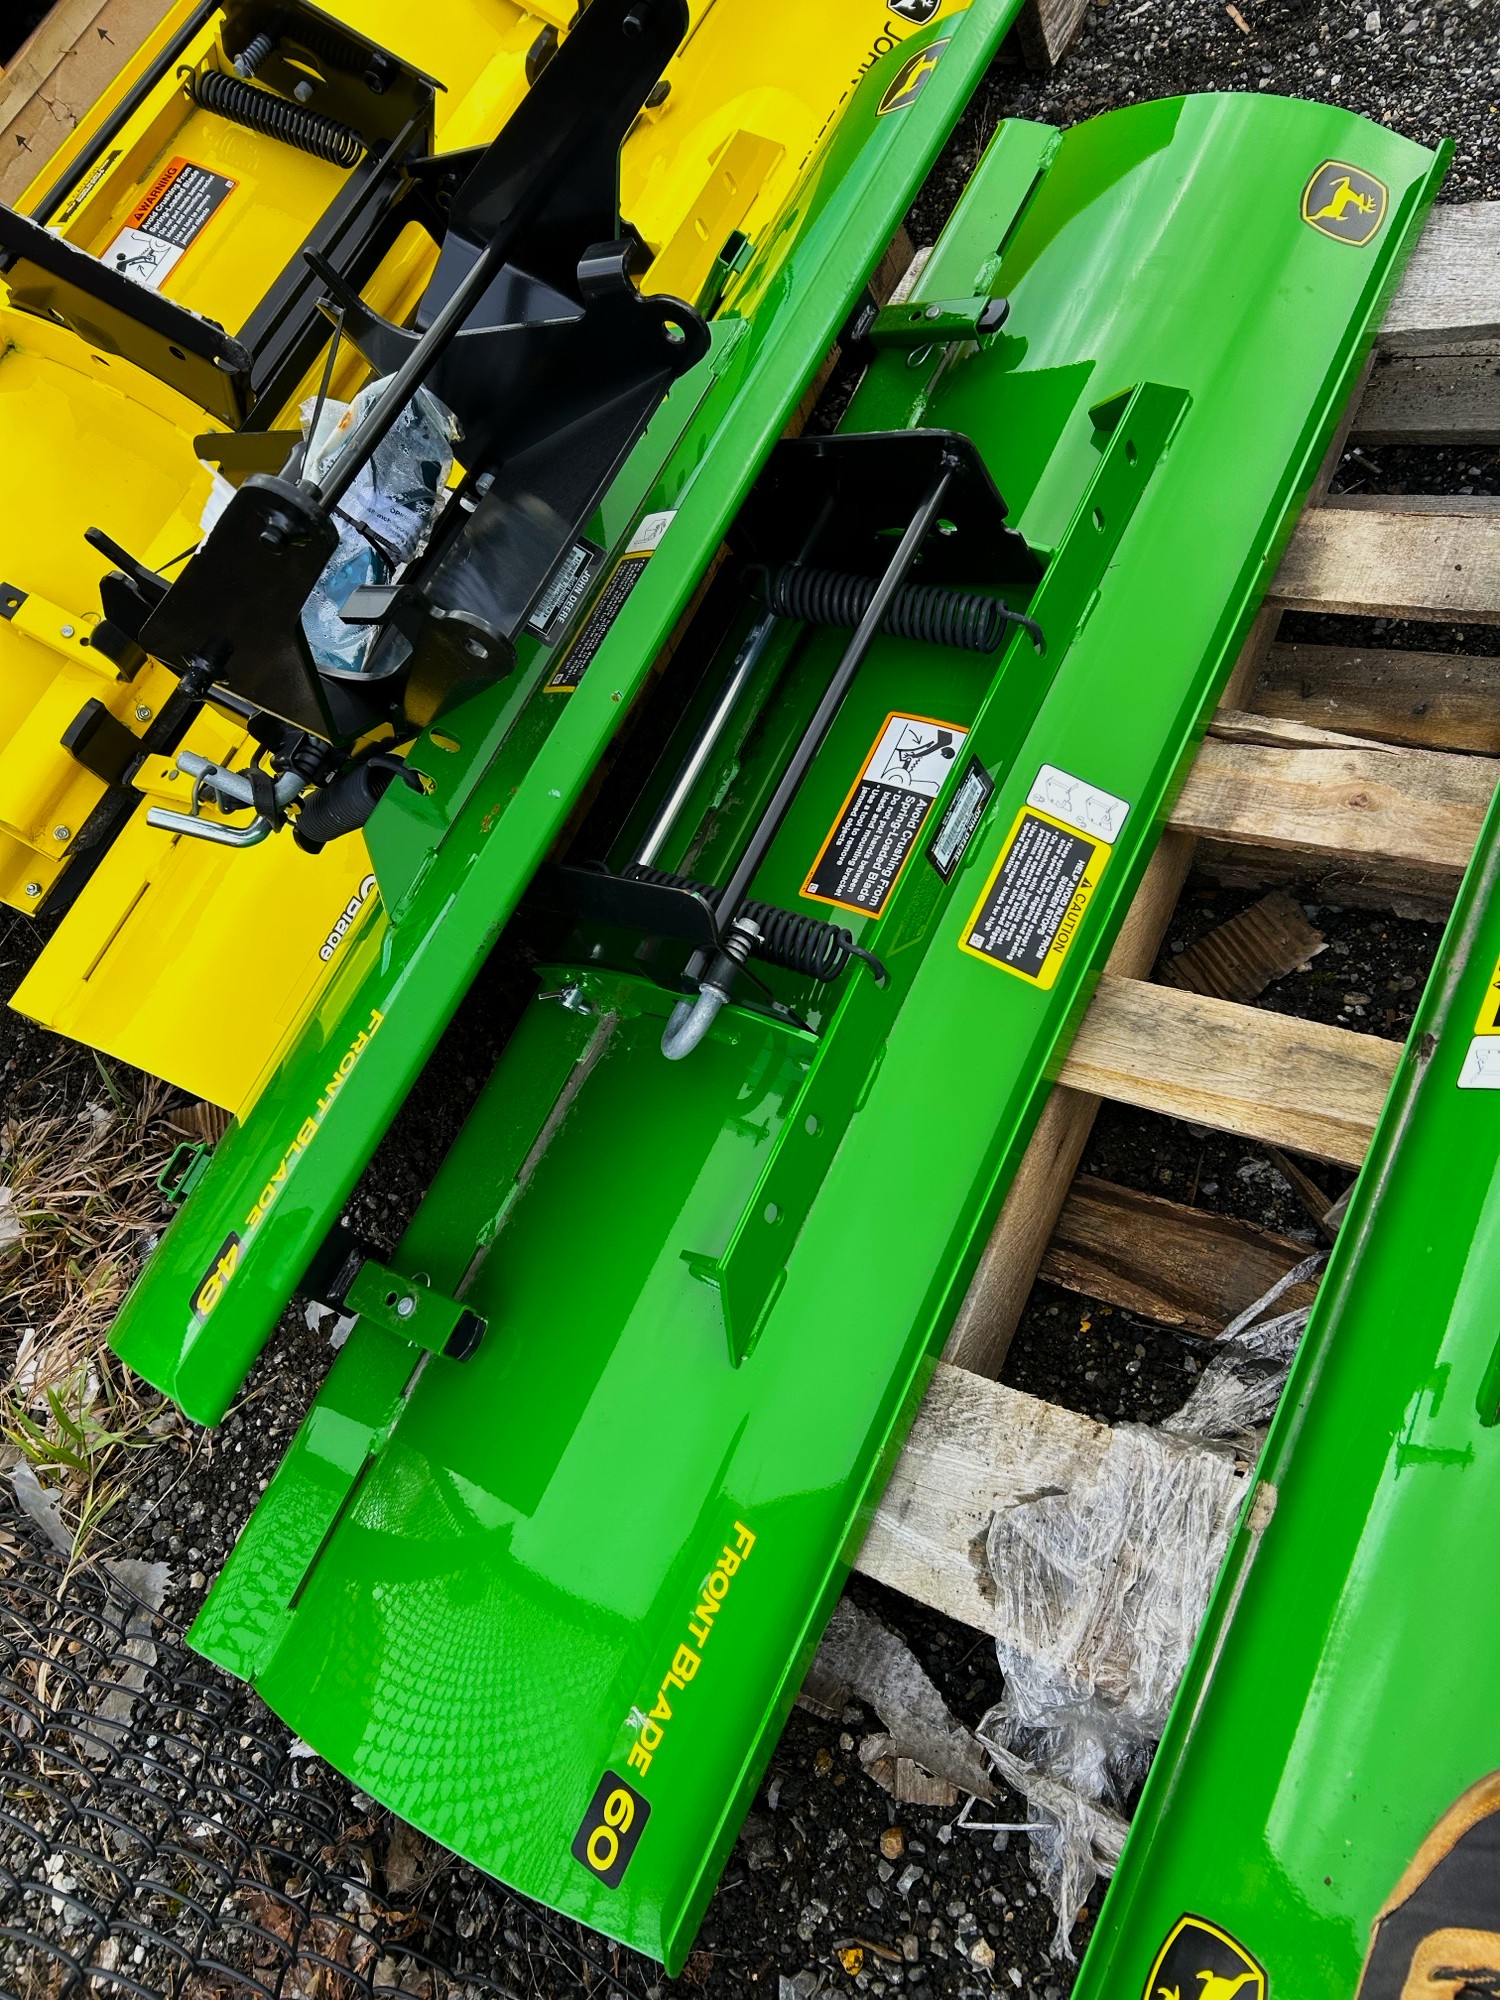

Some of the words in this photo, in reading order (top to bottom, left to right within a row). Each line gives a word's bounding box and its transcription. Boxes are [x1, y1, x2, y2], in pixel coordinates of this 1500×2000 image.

[138, 167, 177, 211] WARNING
[142, 211, 158, 230] Avoid
[155, 183, 181, 212] Crushing
[176, 167, 192, 183] From
[149, 187, 186, 233] Spring-Loaded
[182, 170, 199, 188] Blade
[158, 227, 167, 235] Do
[165, 218, 173, 228] not
[171, 210, 180, 220] put
[177, 195, 191, 211] hands
[188, 176, 205, 196] between
[165, 224, 178, 238] blade
[176, 214, 185, 224] and
[183, 192, 203, 215] mounting
[199, 175, 215, 193] bracket
[173, 231, 183, 241] Use
[183, 217, 193, 228] tool
[196, 194, 211, 212] remove
[179, 225, 197, 245] jammed
[195, 208, 210, 226] objects
[574, 569, 591, 594] JOHN
[557, 595, 577, 624] DEERE
[850, 786, 870, 817] jammed
[867, 789, 879, 804] Use
[876, 791, 891, 813] blade
[890, 794, 901, 805] Do
[856, 811, 868, 827] tool
[867, 813, 879, 829] and
[883, 806, 894, 820] not
[906, 798, 927, 829] Avoid
[968, 806, 981, 831] JOHN
[836, 818, 853, 845] objects
[851, 828, 860, 836] to
[872, 795, 916, 871] Spring-Loaded
[876, 820, 887, 834] put
[1018, 822, 1031, 842] speed
[1028, 825, 1037, 838] Use
[836, 837, 854, 865] remove
[848, 829, 871, 866] mounting
[864, 835, 881, 859] hands
[952, 831, 970, 862] DEERE
[1018, 838, 1031, 860] rubber
[1030, 828, 1046, 855] position
[1035, 831, 1051, 860] pressure
[1049, 835, 1057, 845] On
[1056, 839, 1066, 854] slow
[1060, 842, 1072, 858] Keep
[881, 830, 913, 877] Crushing
[1004, 842, 1022, 873] operation
[1035, 845, 1053, 876] machines
[1046, 855, 1059, 875] speed
[847, 860, 869, 893] between
[1006, 861, 1020, 886] scraper
[1019, 856, 1033, 878] except
[1023, 861, 1038, 885] operate
[1049, 859, 1064, 880] spring
[1071, 859, 1085, 881] HELP
[834, 867, 854, 896] bracket
[857, 872, 878, 901] Blade
[869, 879, 889, 906] From
[1015, 878, 1023, 888] for
[1016, 887, 1027, 901] with
[1028, 877, 1038, 891] with
[1036, 875, 1050, 895] heavy
[1045, 881, 1055, 893] trip
[1049, 875, 1069, 909] SUDDEN
[1060, 881, 1075, 906] AVOID
[997, 886, 1009, 904] blade
[1008, 889, 1018, 905] slow
[1014, 892, 1032, 922] hydraulic
[992, 905, 1001, 916] for
[998, 905, 1010, 926] speed
[1008, 901, 1020, 920] blade
[1024, 896, 1040, 921] digging
[1031, 894, 1048, 924] unlocked
[1047, 906, 1065, 936] INJURY
[984, 916, 996, 931] high
[1004, 920, 1011, 928] in
[1005, 923, 1017, 941] down
[1019, 921, 1028, 935] and
[1037, 908, 1054, 935] STOPS
[1052, 893, 1086, 954] CAUTION
[985, 926, 1001, 951] digging
[996, 929, 1008, 945] float
[1006, 934, 1022, 960] grading
[1021, 924, 1034, 947] except
[1035, 935, 1052, 959] FROM
[1016, 947, 1025, 958] for
[316, 1009, 385, 1119] FRONT
[245, 1116, 321, 1232] BLADE
[196, 1243, 246, 1318] 48
[688, 1521, 756, 1648] FRONT
[627, 1643, 701, 1777] BLADE
[587, 1789, 634, 1871] 60
